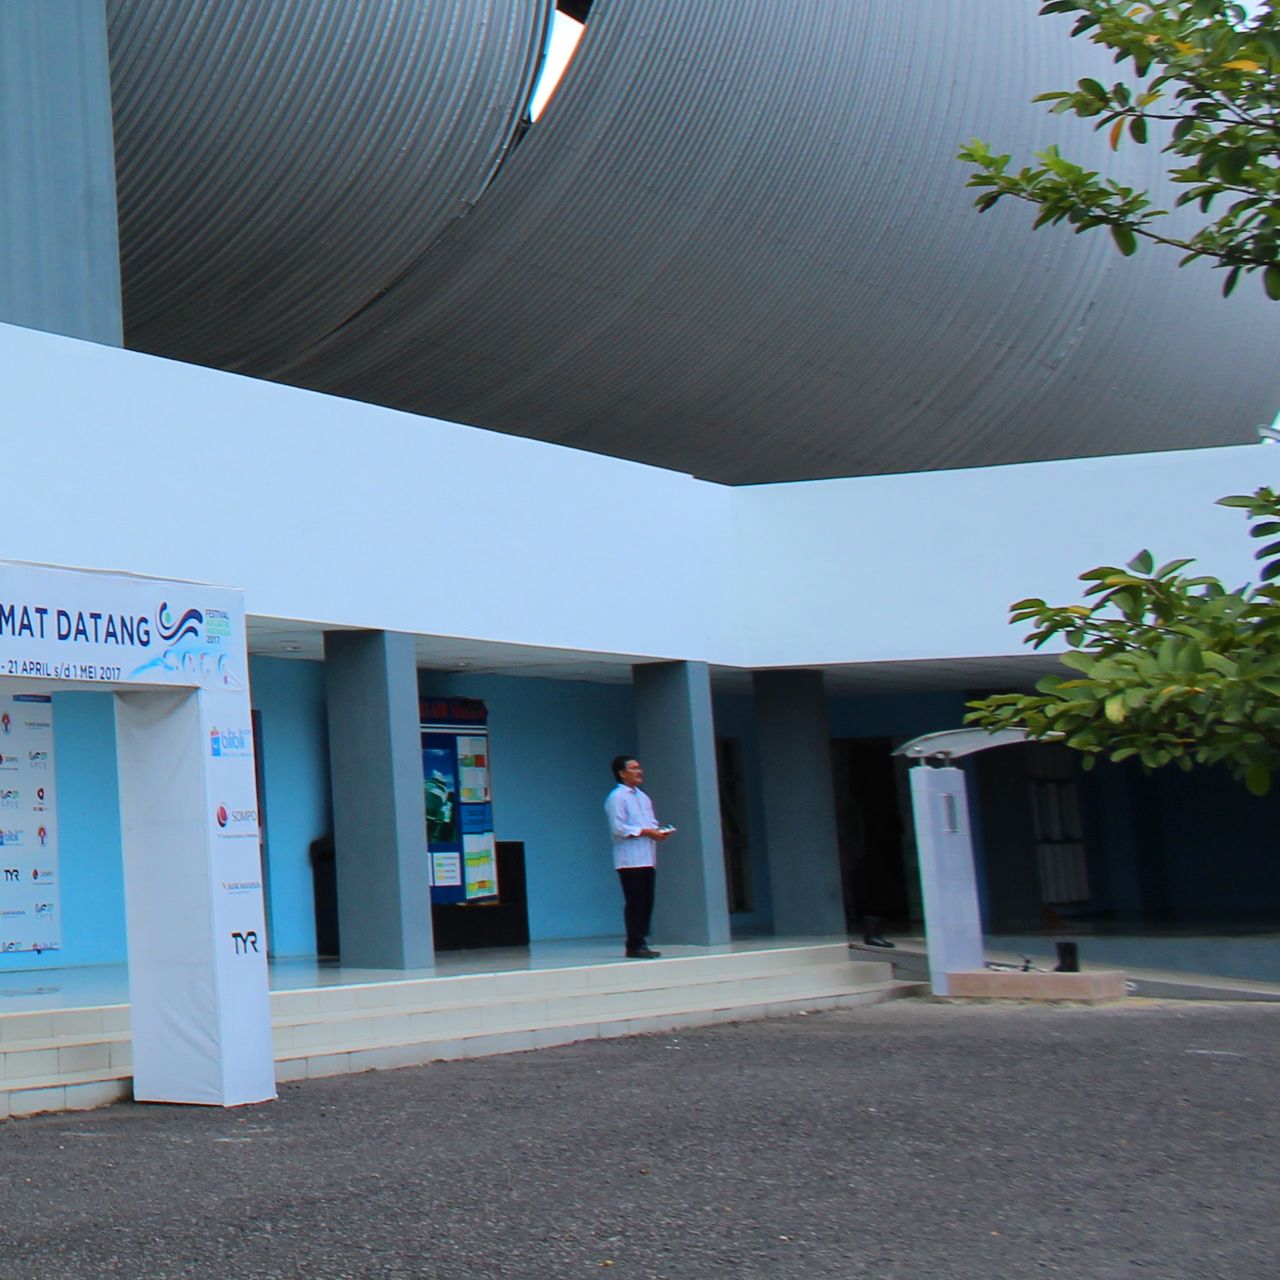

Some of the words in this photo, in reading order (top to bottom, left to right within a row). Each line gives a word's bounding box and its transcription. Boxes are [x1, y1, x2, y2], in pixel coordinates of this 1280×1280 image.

[56, 610, 151, 647] DATANG
[8, 660, 19, 674] 21
[21, 661, 52, 677] APRIL
[79, 665, 98, 679] MEI
[100, 666, 121, 680] 2017
[231, 931, 259, 954] TYR
